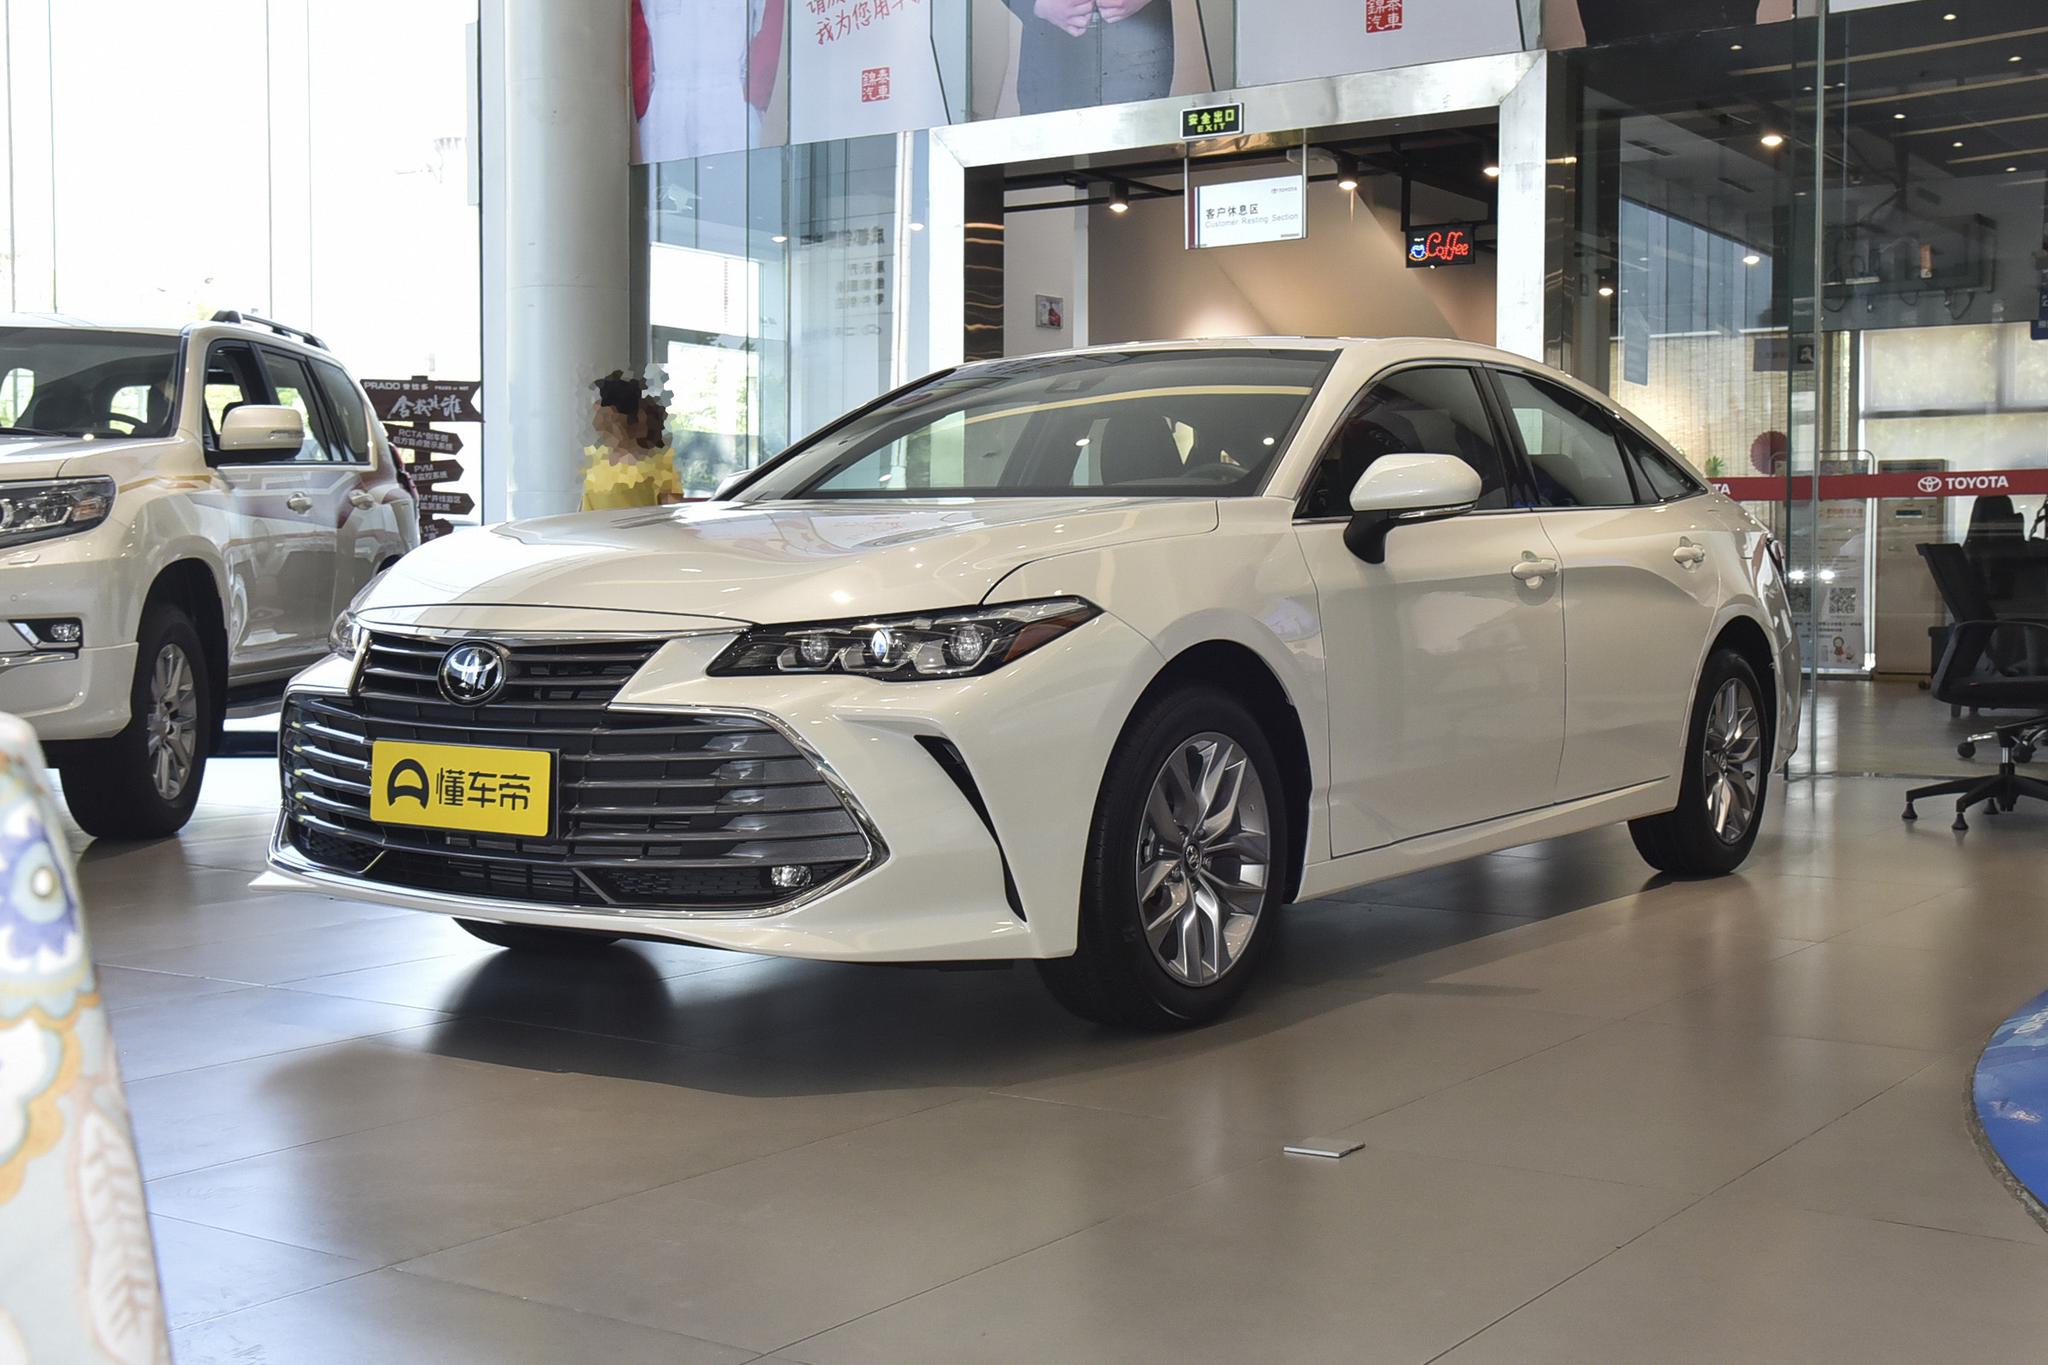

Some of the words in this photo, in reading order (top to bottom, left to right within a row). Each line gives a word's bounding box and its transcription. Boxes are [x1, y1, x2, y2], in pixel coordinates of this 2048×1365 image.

[1188, 109, 1235, 126] 安全出口
[1197, 122, 1226, 133] EXIT
[1205, 203, 1259, 220] 客户休息区
[1205, 219, 1239, 229] Customer
[1241, 216, 1269, 225] Resting
[1272, 213, 1299, 222] Section
[1426, 231, 1469, 261] Coffee
[364, 381, 400, 390] PRADO
[1945, 475, 2009, 490] TOYOTA
[436, 767, 531, 811] 懂车帝
